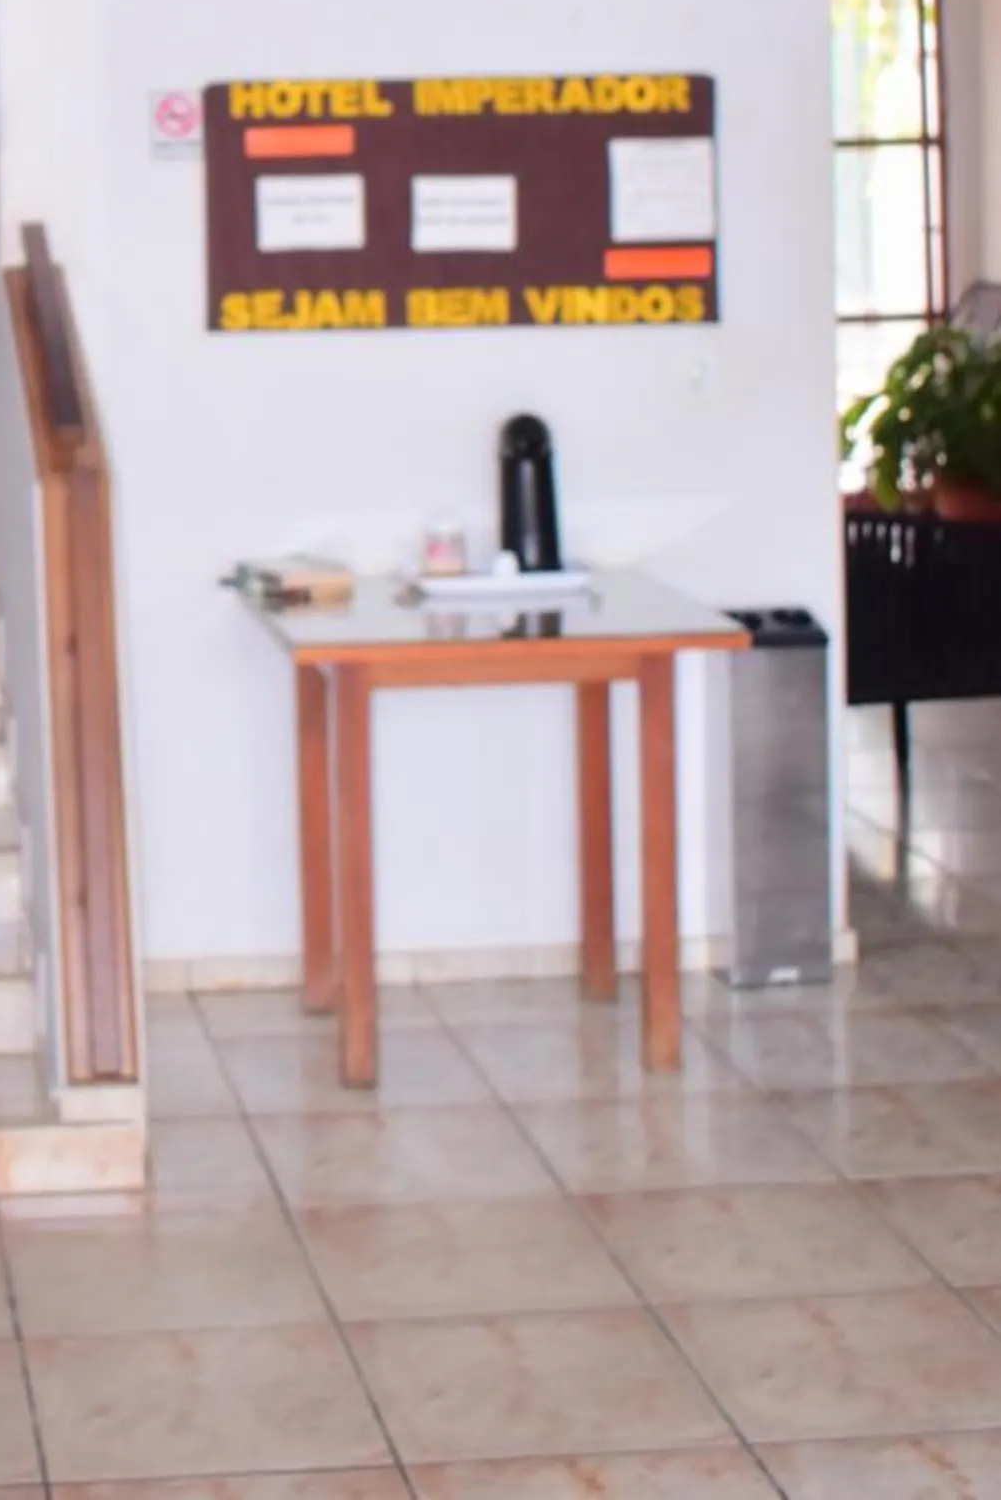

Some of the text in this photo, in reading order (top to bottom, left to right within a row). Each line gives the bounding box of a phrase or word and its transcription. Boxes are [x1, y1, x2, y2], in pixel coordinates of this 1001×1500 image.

[230, 76, 689, 117] HOTEL IMPERADOR
[220, 285, 704, 330] SEJAM BEM VINDOS
